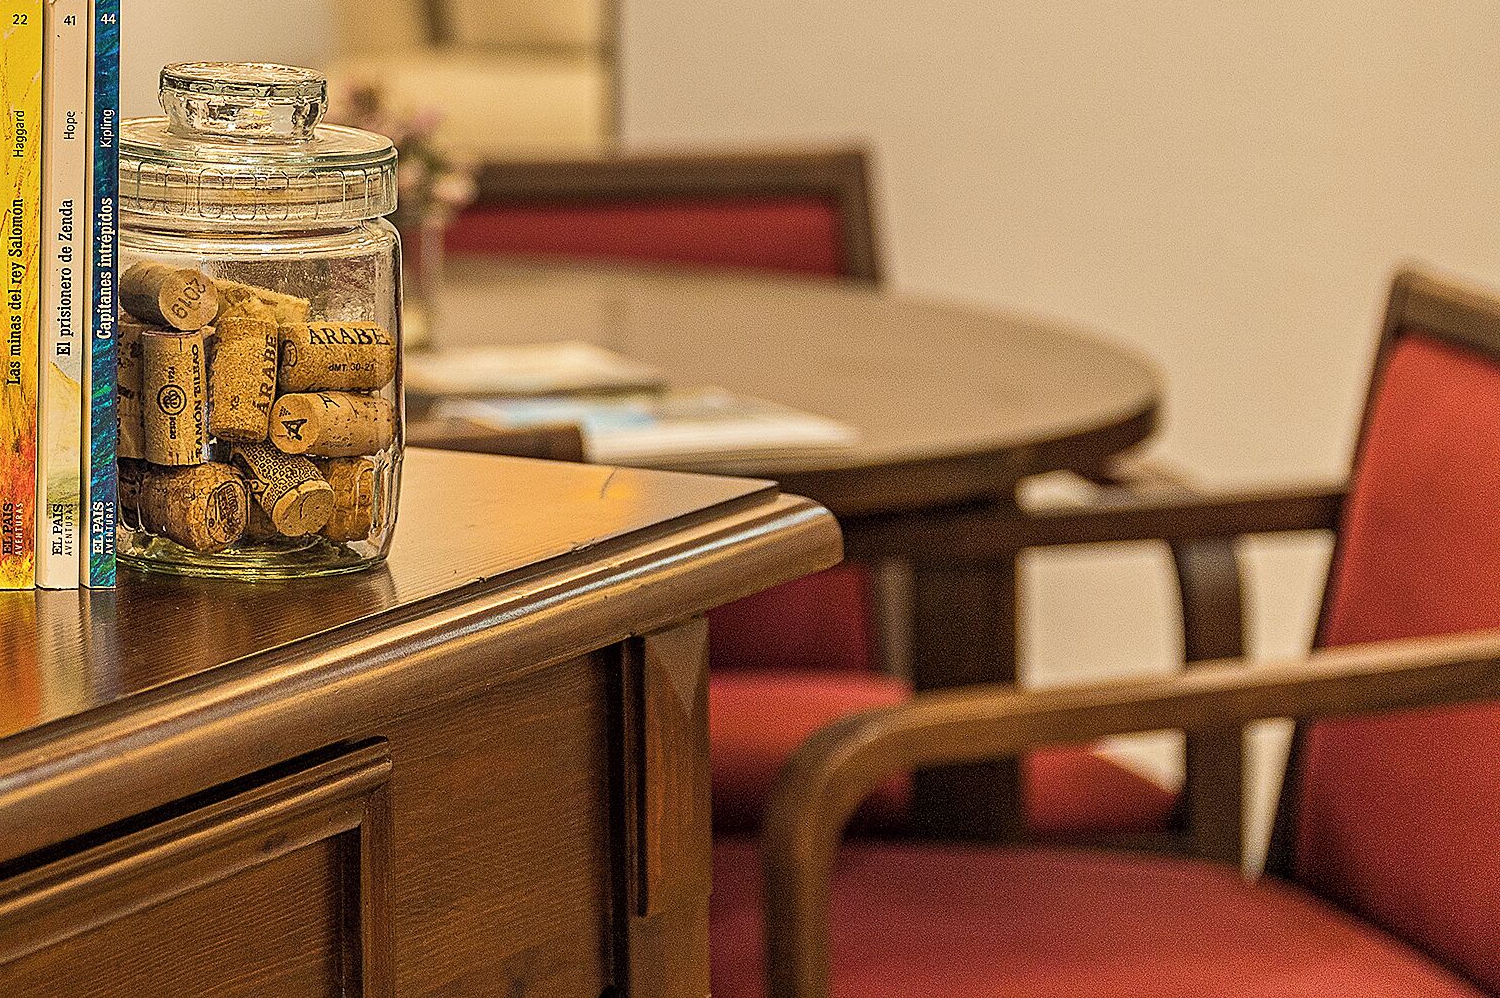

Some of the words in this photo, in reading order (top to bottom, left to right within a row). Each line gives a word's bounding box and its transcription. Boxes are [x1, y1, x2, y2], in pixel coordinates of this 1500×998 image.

[12, 14, 28, 25] 22
[63, 15, 76, 26] 41
[100, 14, 116, 25] 44
[13, 109, 27, 158] Haggard
[64, 110, 77, 140] Hope
[100, 108, 115, 149] Kipling
[6, 197, 25, 256] Salomón
[58, 198, 73, 240] Zenda
[96, 196, 115, 266] intrépidos
[7, 263, 25, 283] rey
[58, 247, 72, 262] de
[8, 290, 21, 309] del
[56, 268, 74, 336] prisionero
[96, 273, 114, 340] Capitanes
[171, 277, 206, 319] 2019
[7, 316, 25, 355] minas
[57, 342, 70, 357] El
[6, 362, 25, 387] Las
[191, 344, 202, 397] BILBAO
